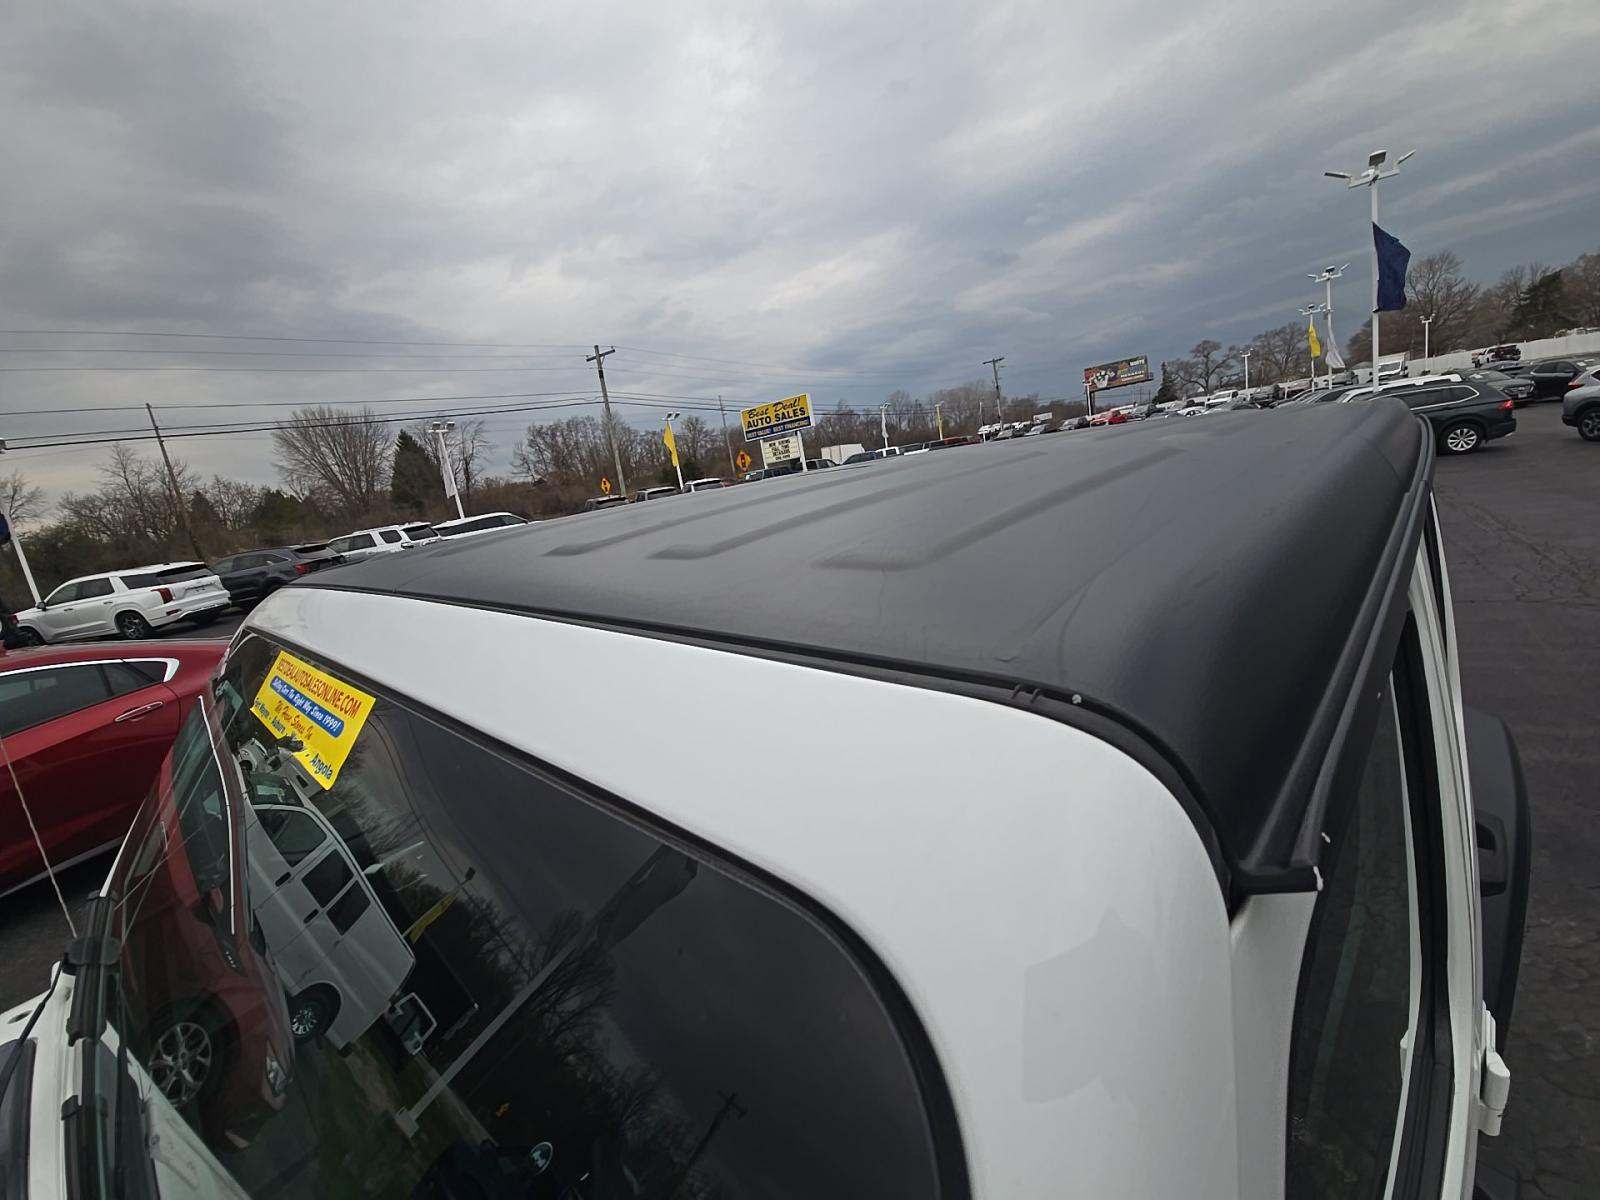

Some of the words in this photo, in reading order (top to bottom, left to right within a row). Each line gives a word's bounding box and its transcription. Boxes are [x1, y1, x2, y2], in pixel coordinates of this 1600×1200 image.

[747, 416, 771, 429] AUTO
[775, 407, 805, 422] SALES
[748, 407, 769, 419] Best
[772, 397, 801, 412] Deal!
[294, 691, 304, 706] Right
[303, 698, 311, 713] Way
[310, 704, 324, 720] Since
[323, 713, 342, 732] 1999!
[310, 752, 334, 779] Angola
